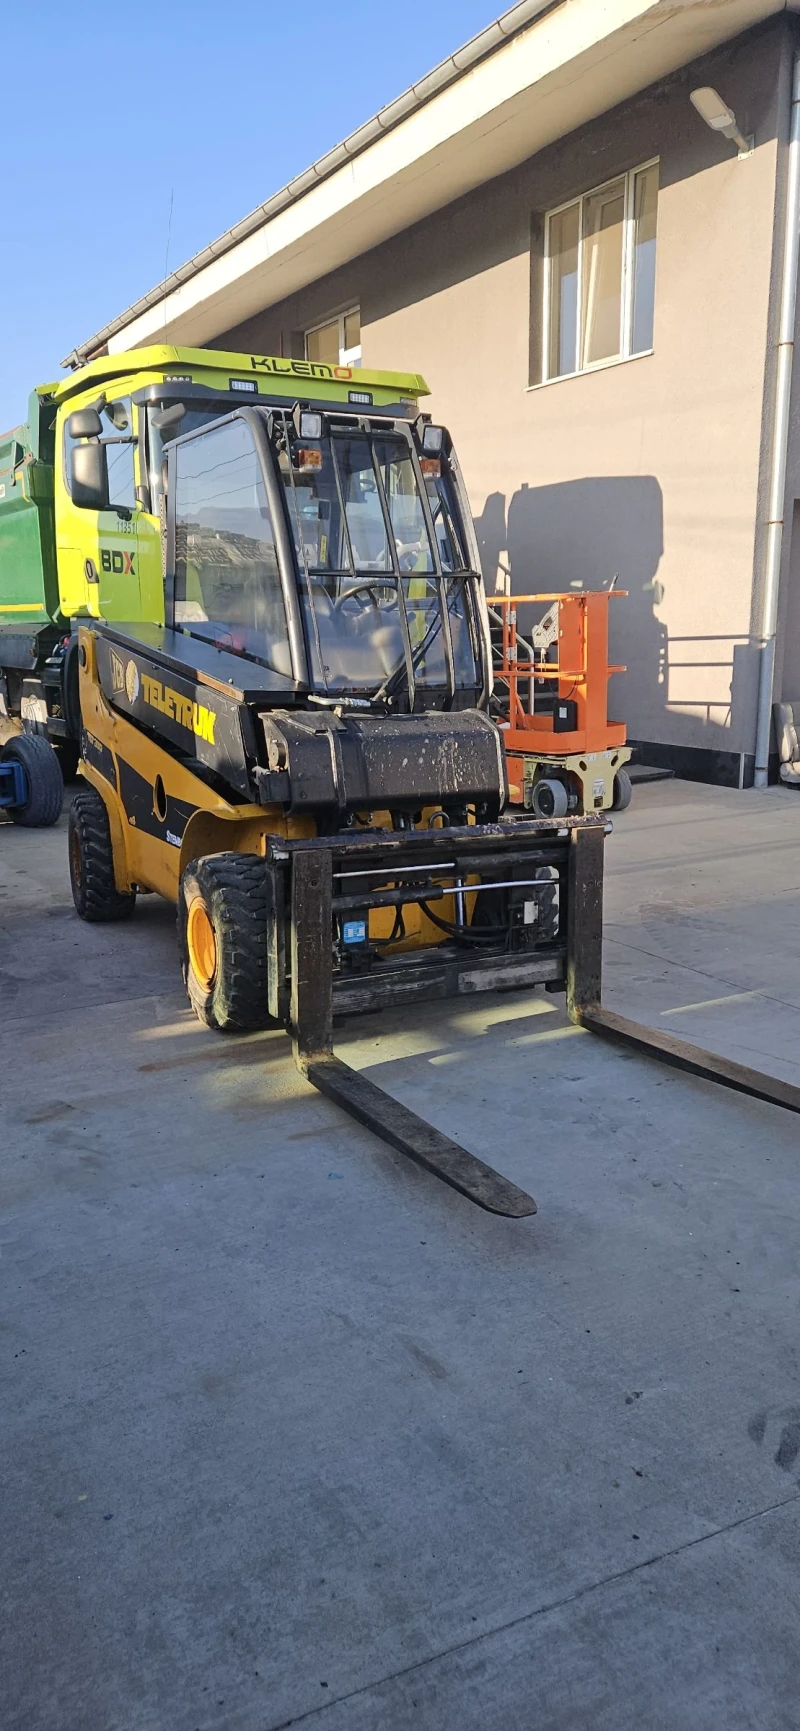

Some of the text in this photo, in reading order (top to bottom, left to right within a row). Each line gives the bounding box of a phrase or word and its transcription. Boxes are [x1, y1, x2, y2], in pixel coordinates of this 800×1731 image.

[251, 357, 352, 380] KLEMO
[117, 521, 136, 535] 11351
[101, 549, 136, 576] BDX
[141, 672, 217, 745] TELETRUK
